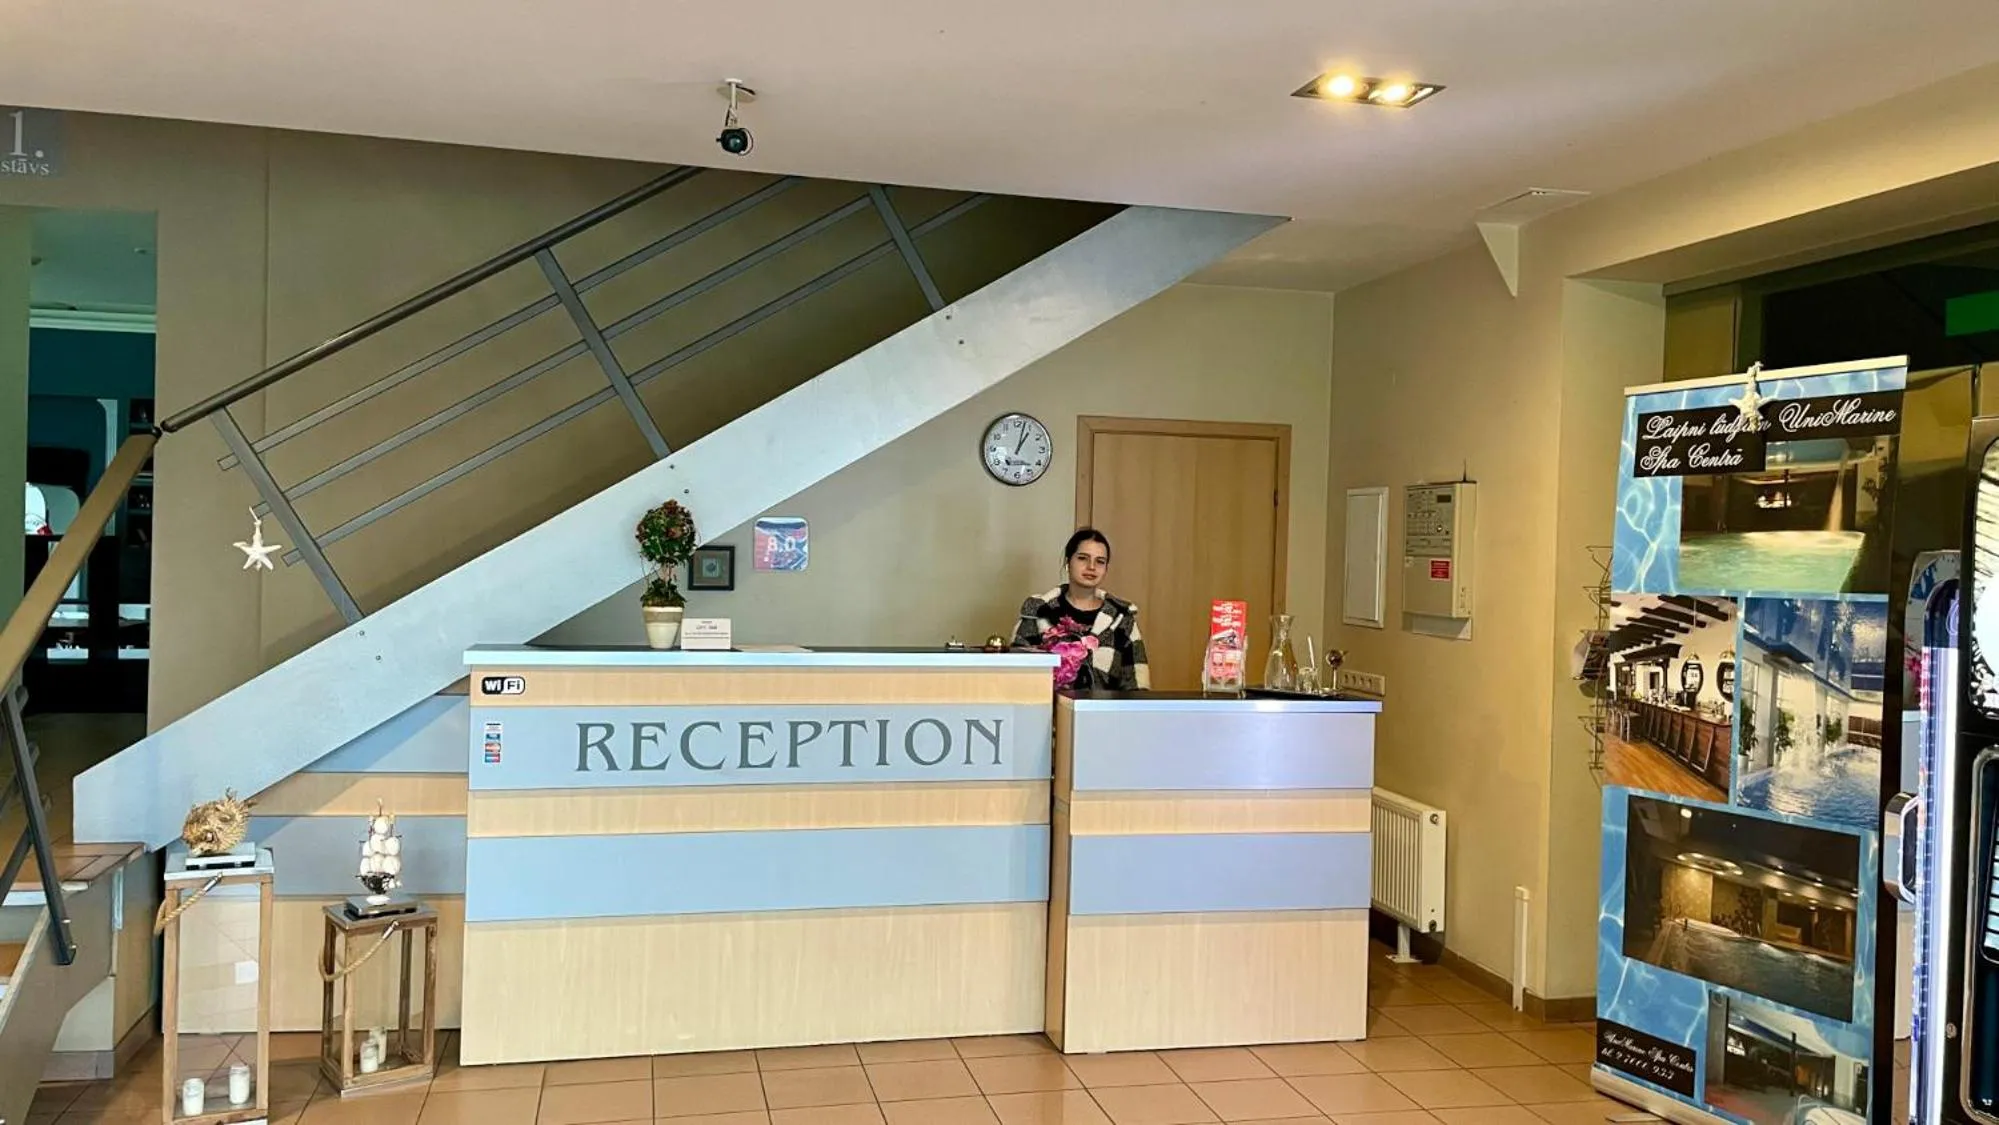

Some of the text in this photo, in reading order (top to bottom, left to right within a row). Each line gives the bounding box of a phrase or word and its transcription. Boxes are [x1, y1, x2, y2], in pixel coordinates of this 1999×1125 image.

[9, 110, 44, 158] 1.
[0, 158, 50, 176] stāvs
[1642, 415, 1706, 444] Laipni
[1778, 397, 1896, 433] UniMarine
[1640, 442, 1743, 475] Spa Centrā
[575, 718, 1004, 772] RECEPTION
